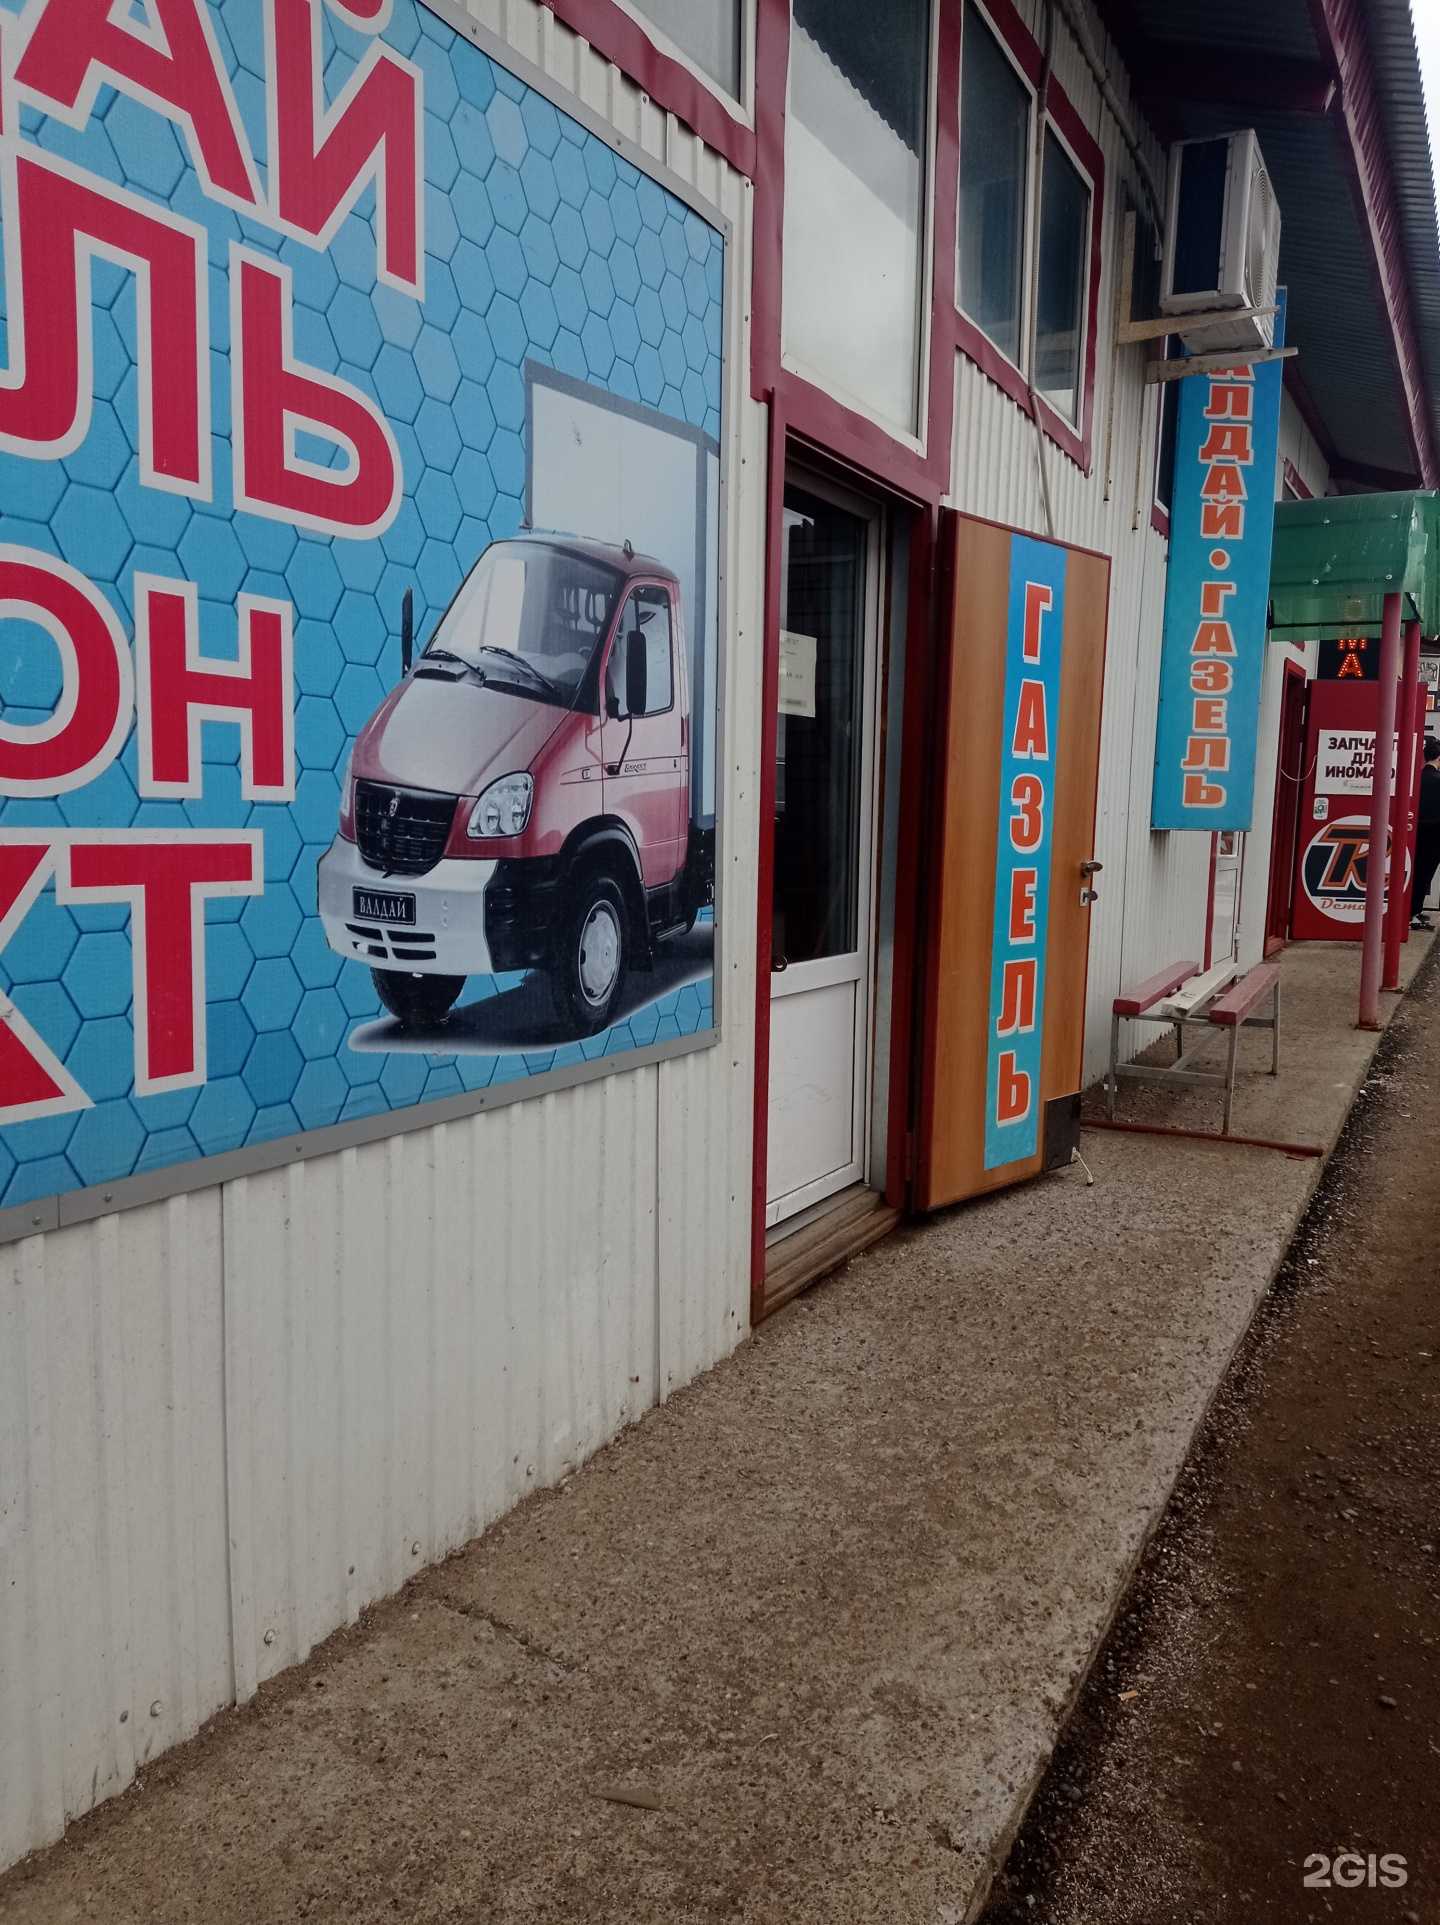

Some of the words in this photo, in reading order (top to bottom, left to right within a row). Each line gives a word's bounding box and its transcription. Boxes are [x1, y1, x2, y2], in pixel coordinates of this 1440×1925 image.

[0, 0, 425, 302] АЙ
[1180, 581, 1238, 808] ГАЗЕЛЬ
[1351, 752, 1375, 766] ДЛ
[359, 895, 407, 919] ВАЛДАЙ
[996, 580, 1053, 1129] ГАЗЕЛЬ
